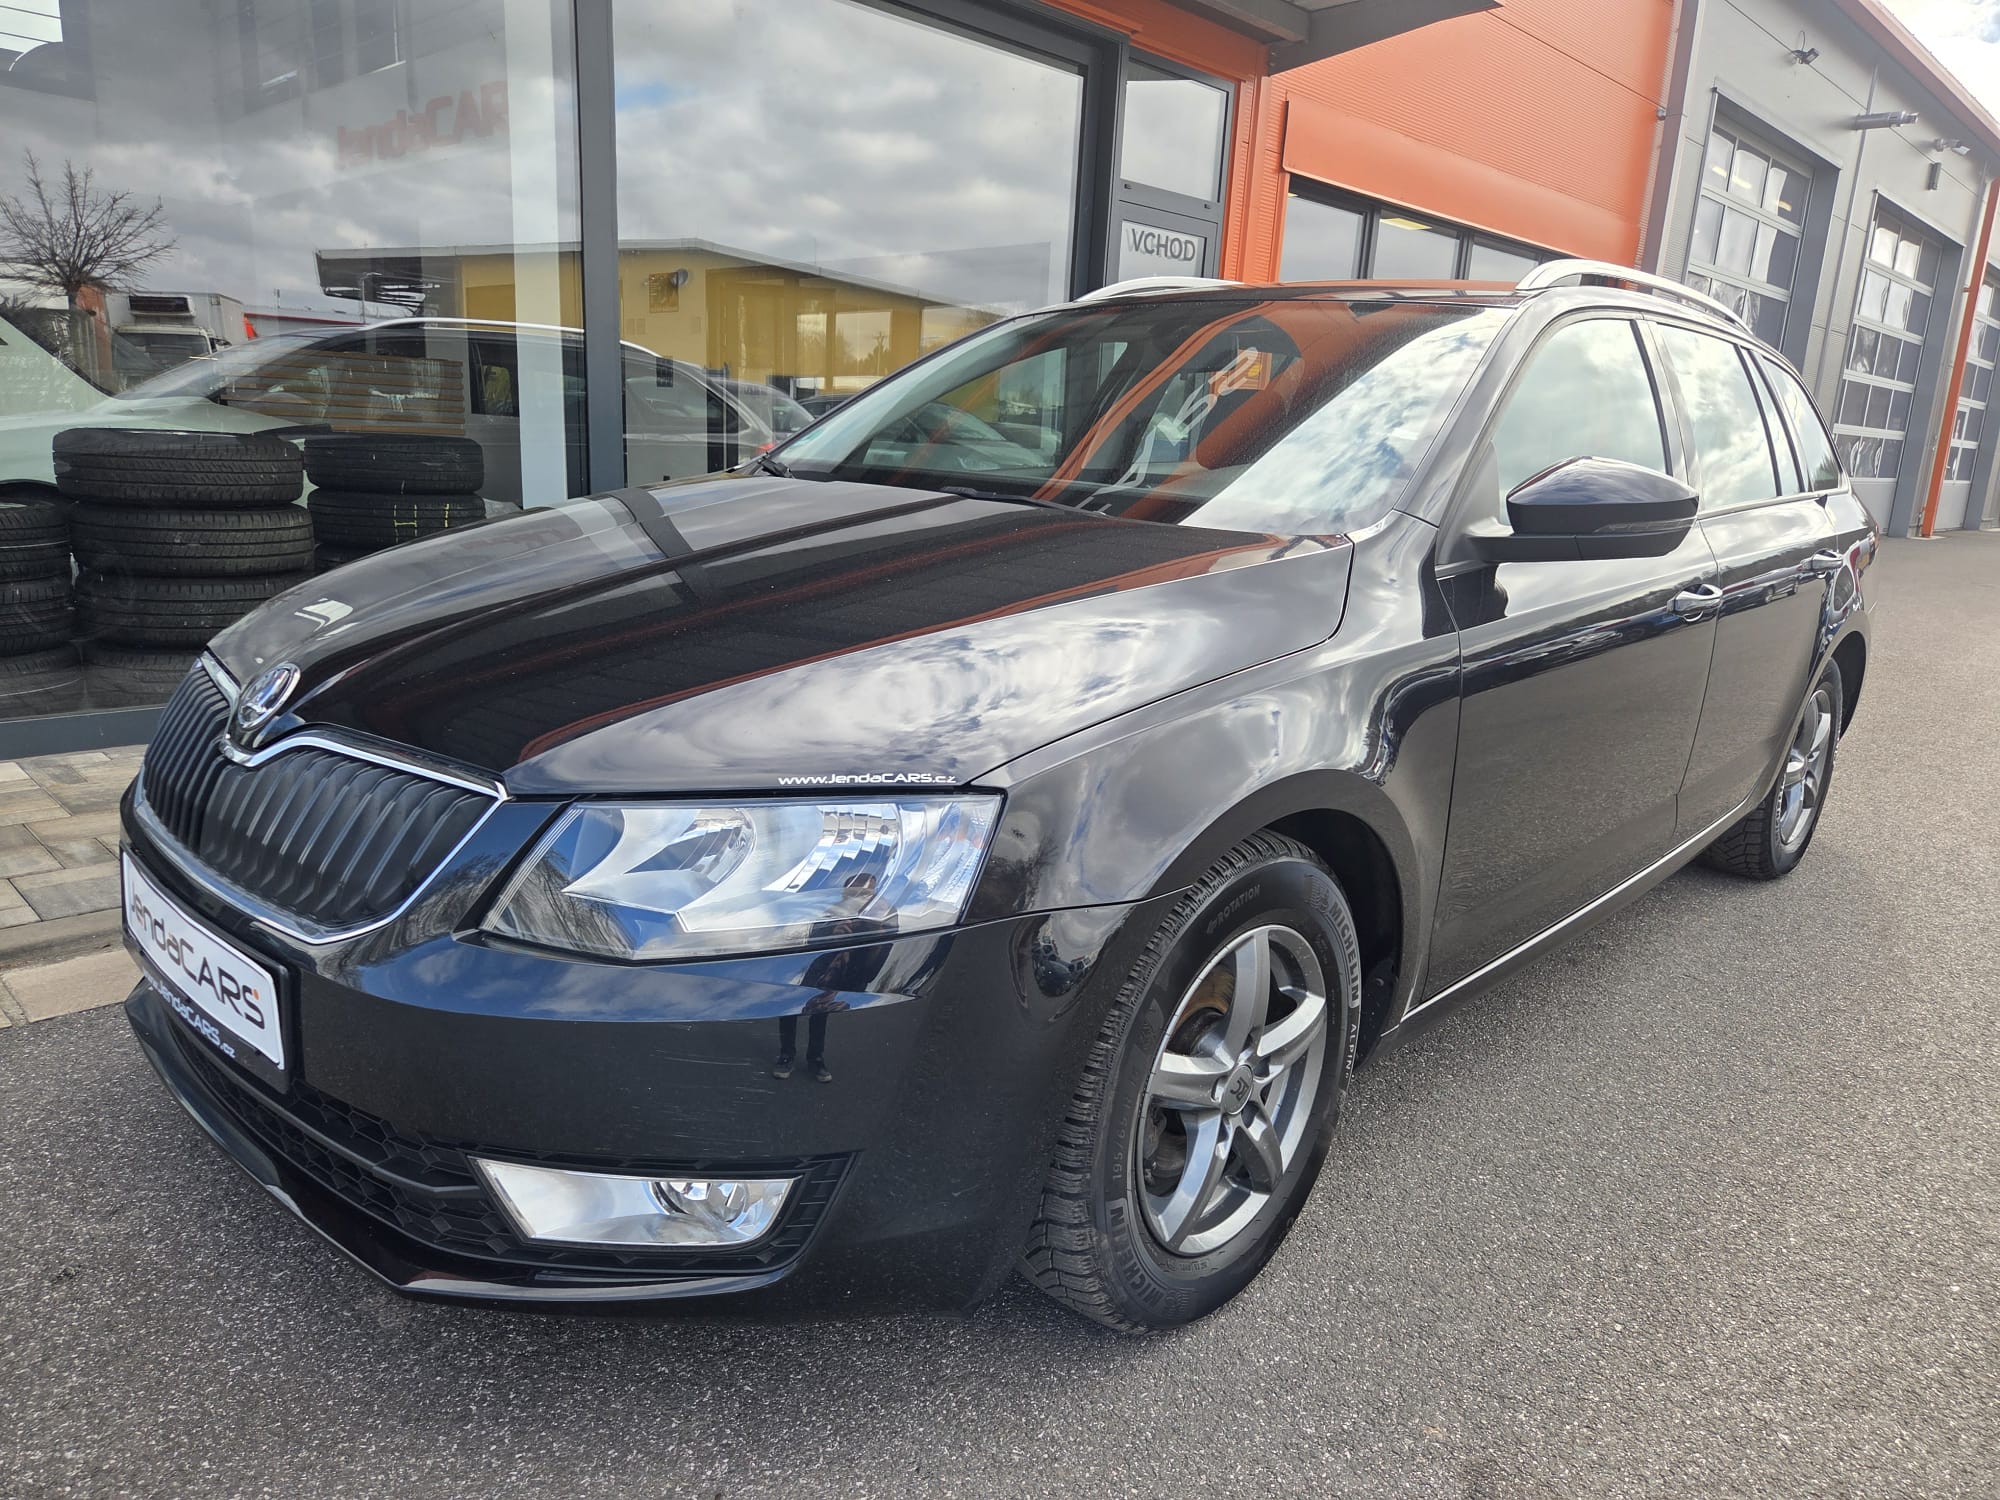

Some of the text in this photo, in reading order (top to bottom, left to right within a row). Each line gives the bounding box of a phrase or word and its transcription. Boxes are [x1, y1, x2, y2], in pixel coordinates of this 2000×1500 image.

[1132, 228, 1196, 261] VCHOD
[778, 773, 957, 785] www.JendaCARS.cz
[1217, 883, 1261, 926] ROTATION
[1329, 902, 1359, 1001] MICHELIN
[1109, 1205, 1166, 1311] MICHELIN
